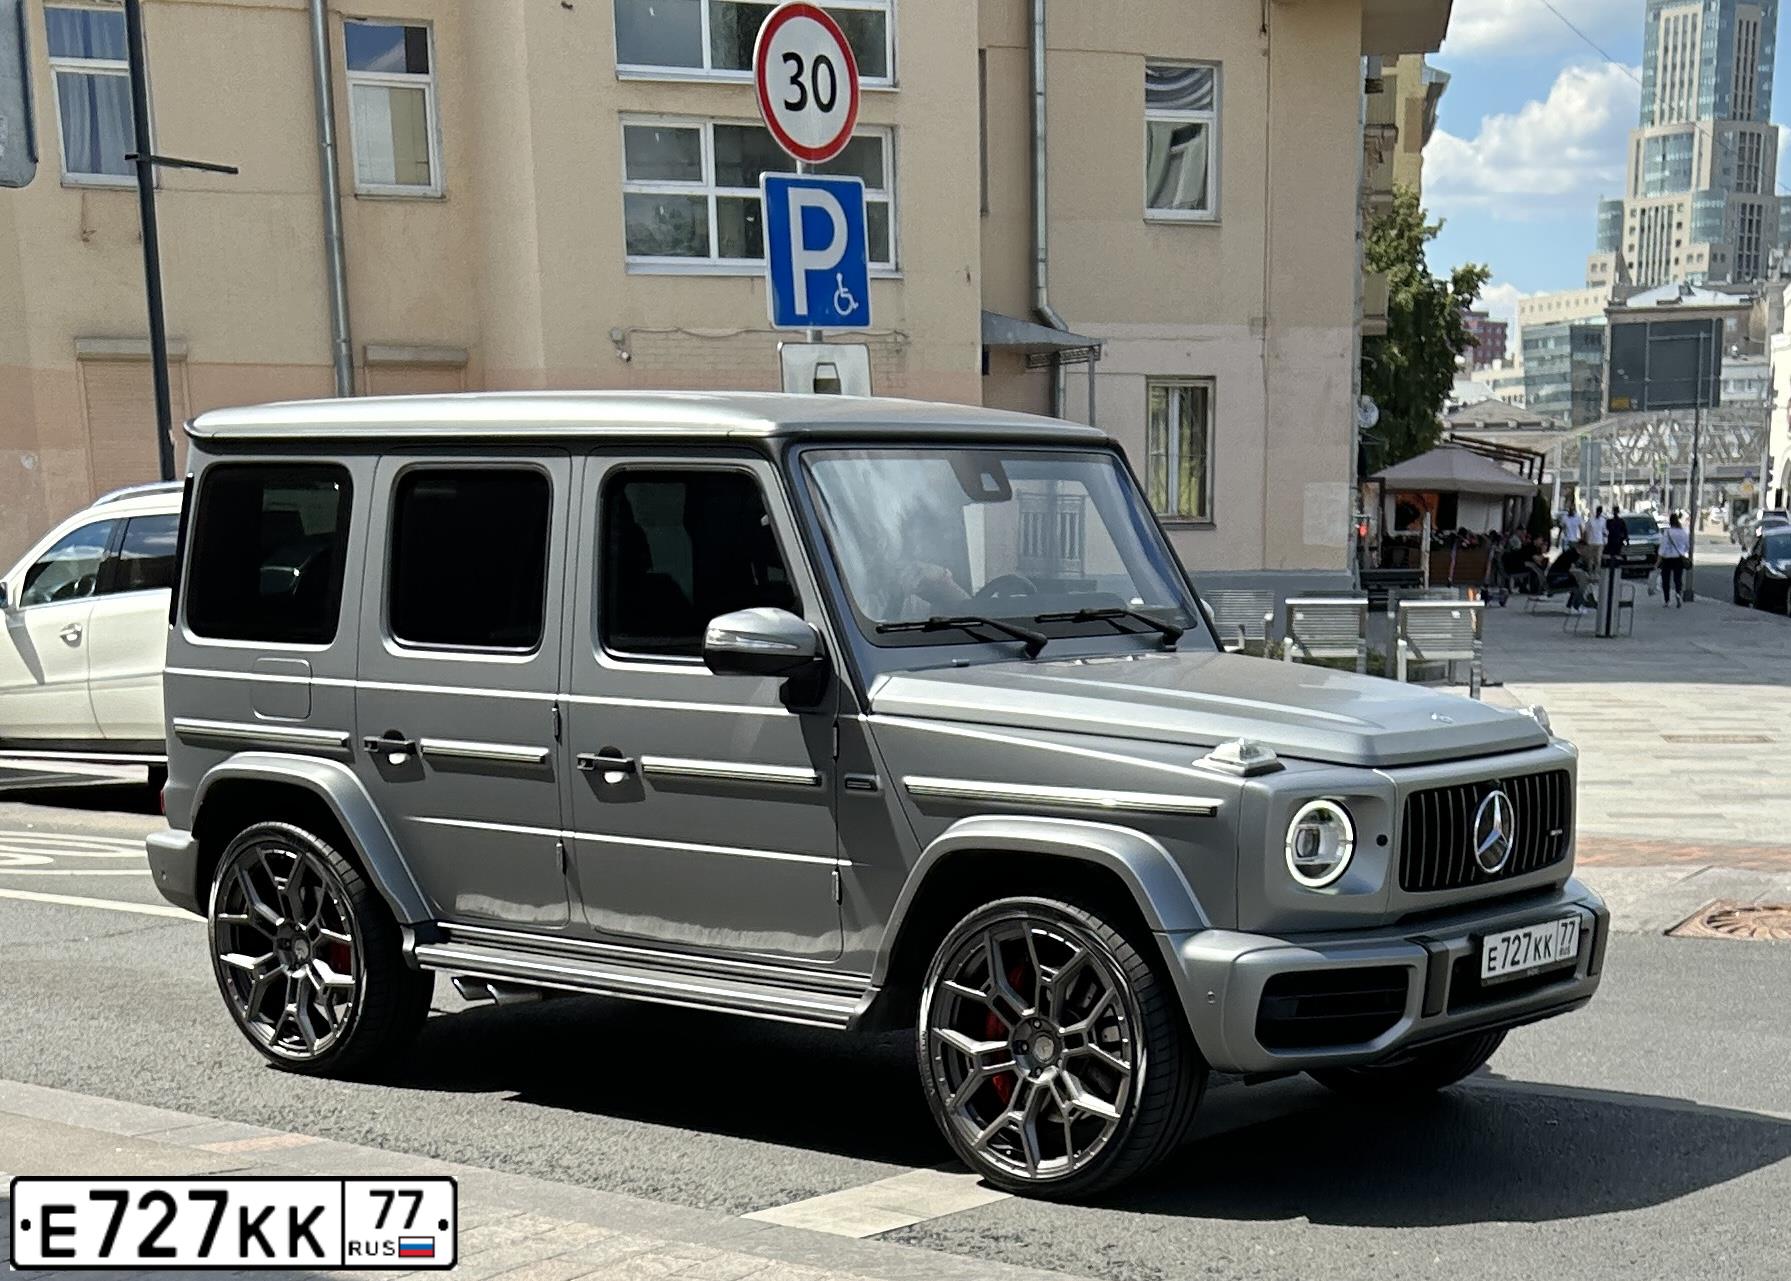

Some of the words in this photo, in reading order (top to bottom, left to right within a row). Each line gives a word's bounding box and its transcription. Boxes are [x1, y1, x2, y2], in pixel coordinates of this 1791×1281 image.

[782, 52, 837, 113] 30
[788, 188, 848, 315] P
[1561, 921, 1576, 946] 77
